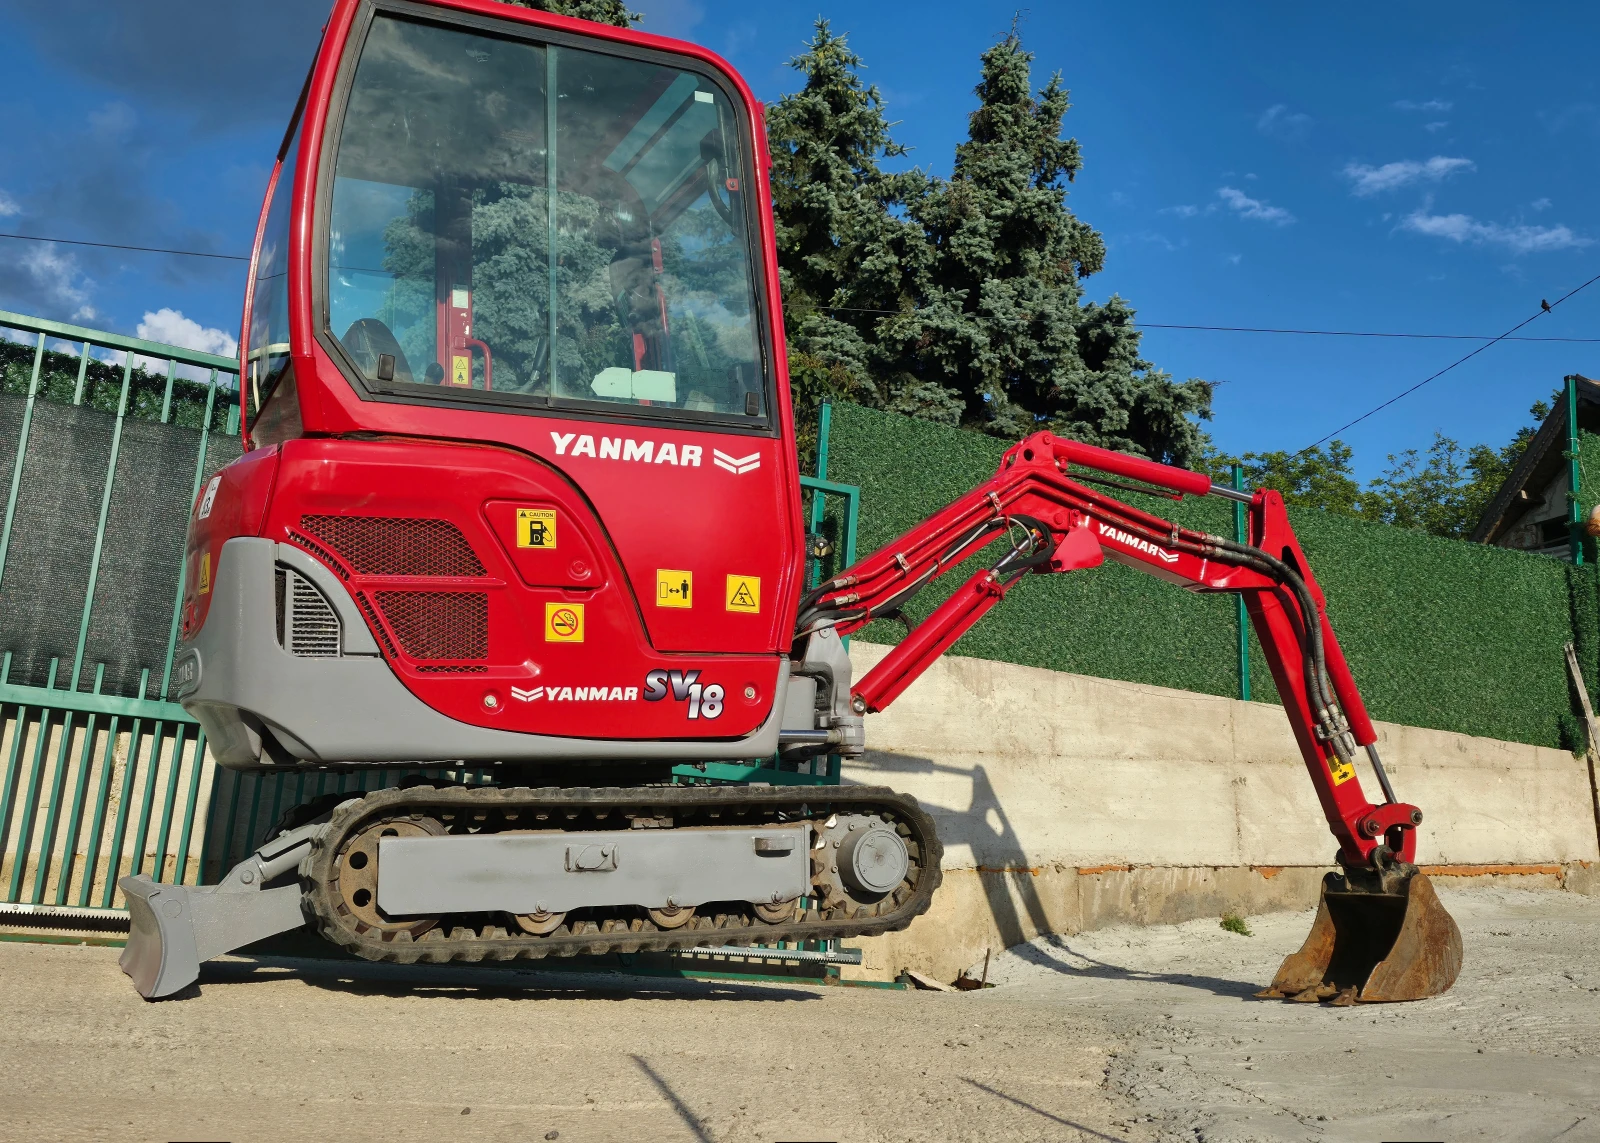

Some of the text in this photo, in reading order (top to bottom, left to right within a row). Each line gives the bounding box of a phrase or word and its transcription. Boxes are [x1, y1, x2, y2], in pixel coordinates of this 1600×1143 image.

[550, 432, 703, 467] YANMAR
[533, 533, 541, 543] D
[1099, 522, 1159, 556] YANMAR
[545, 668, 725, 720] YANMAR SV 18
